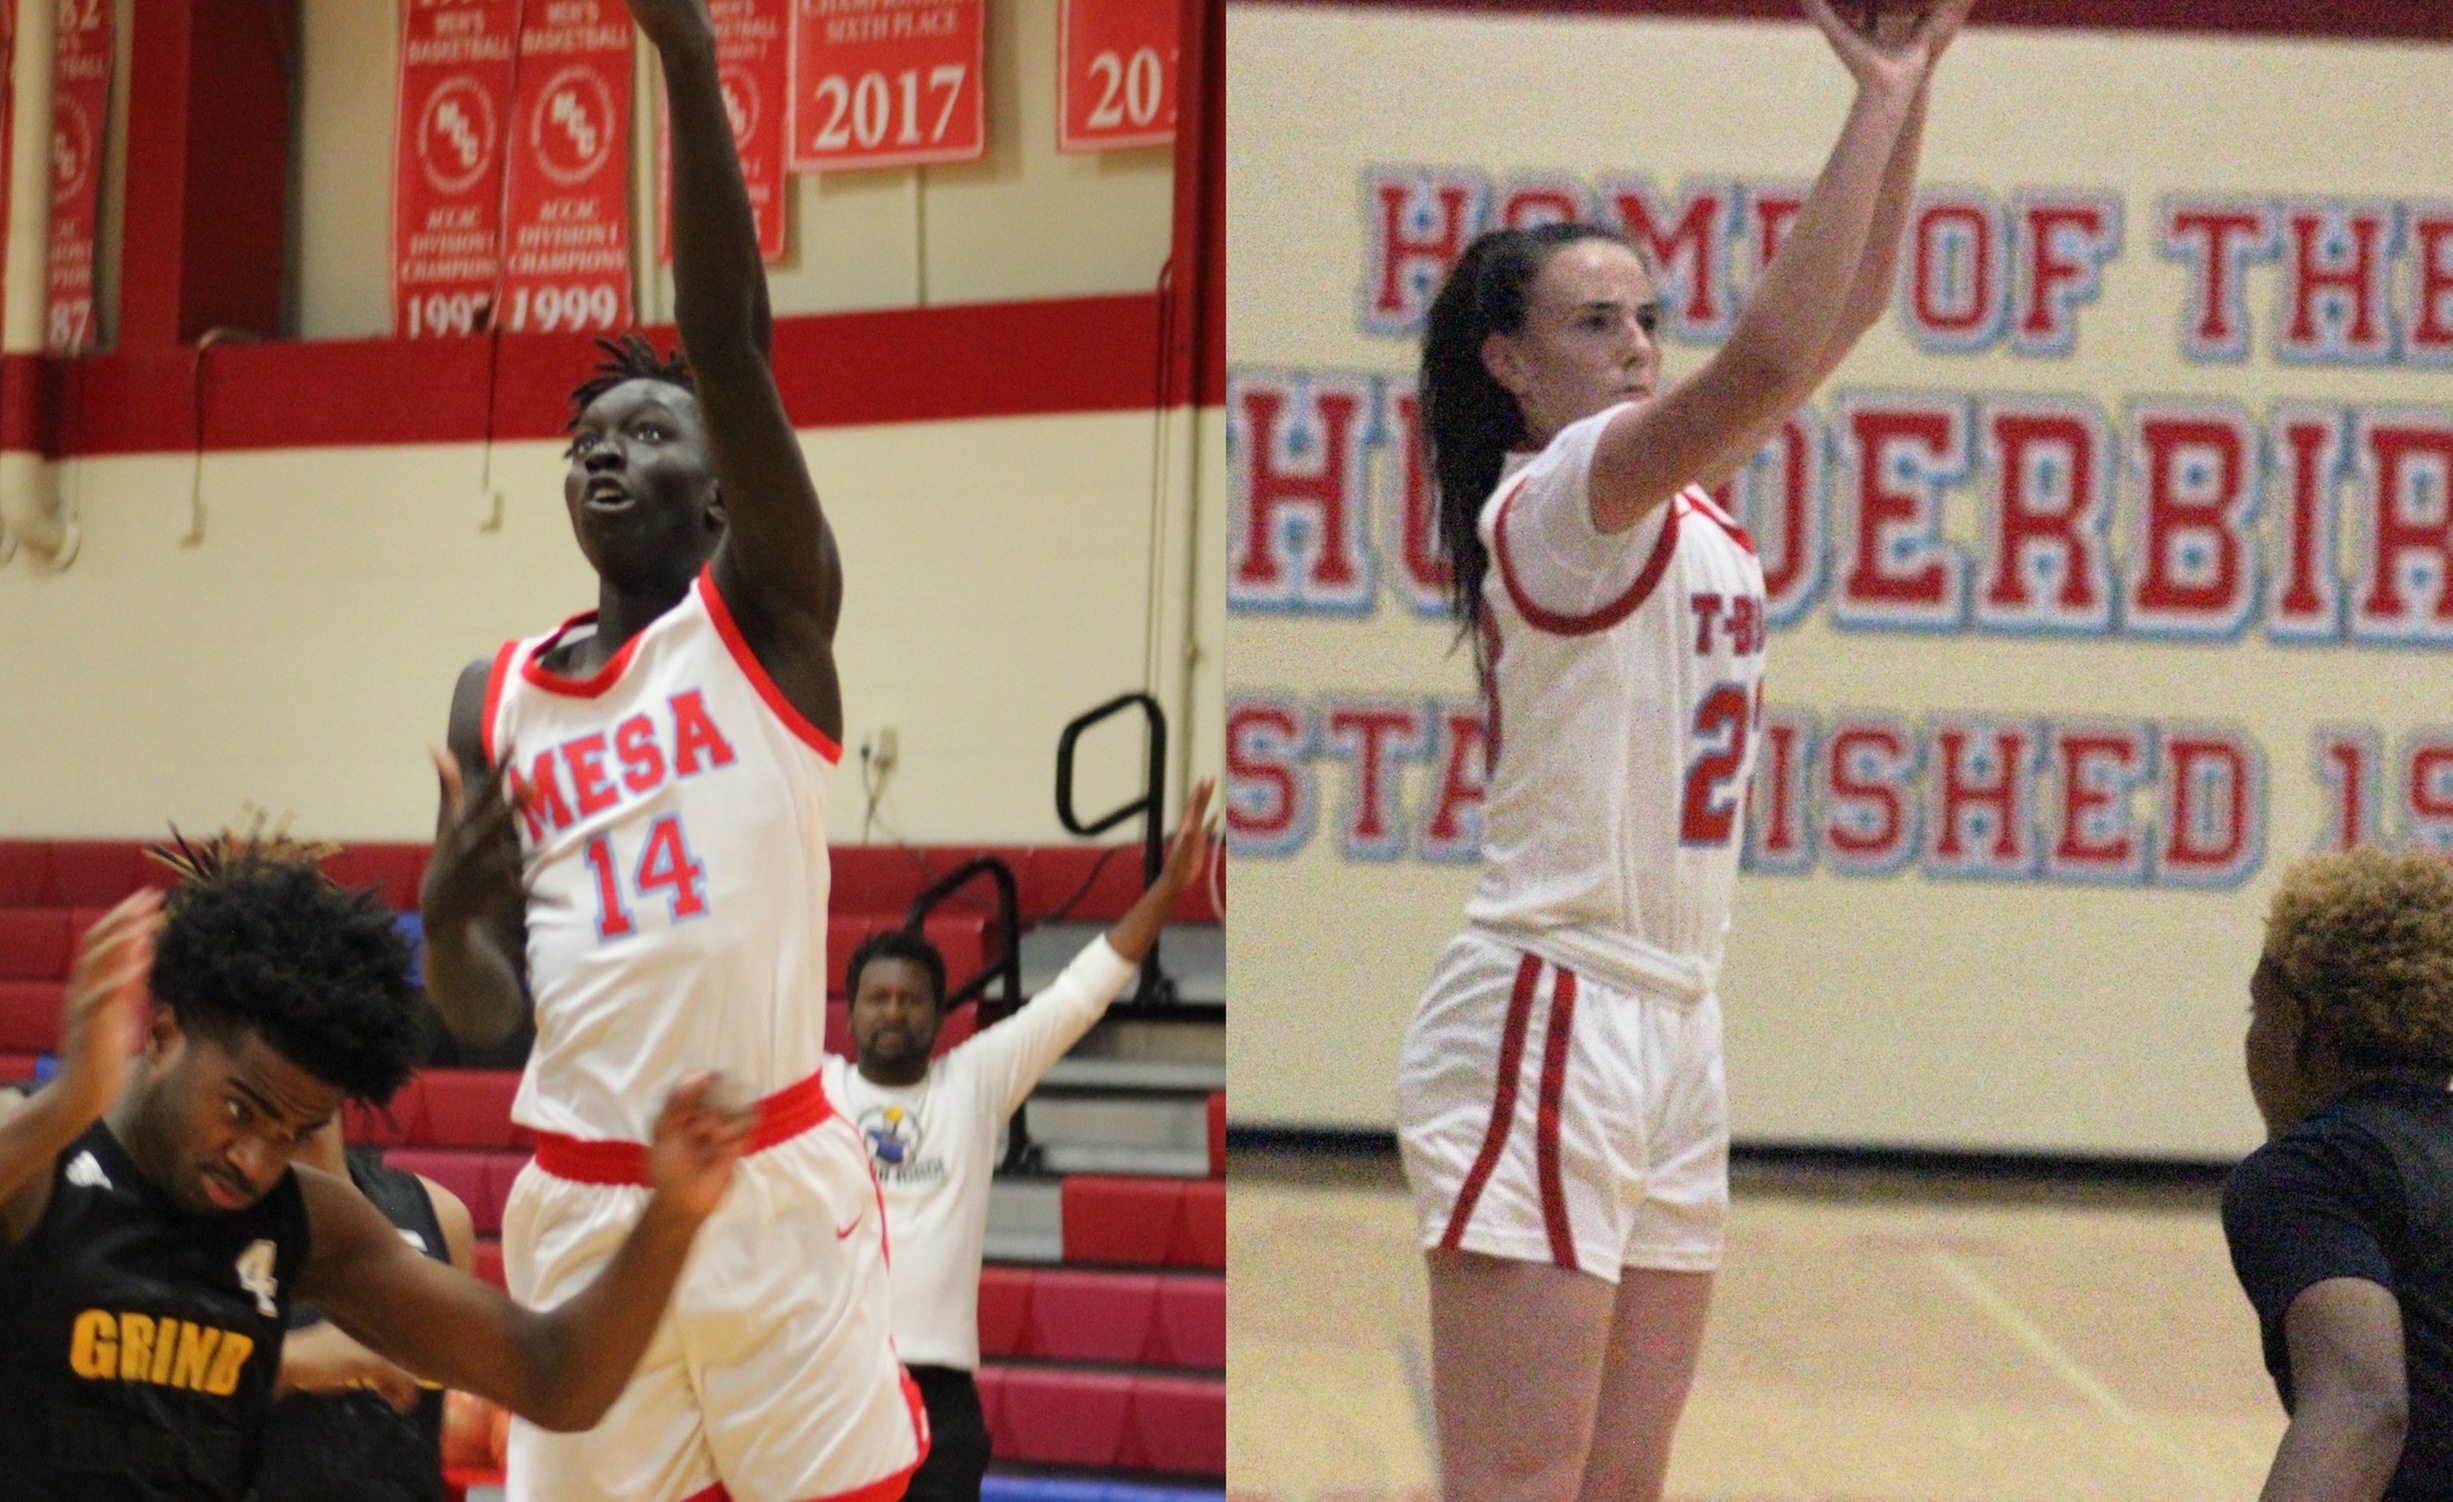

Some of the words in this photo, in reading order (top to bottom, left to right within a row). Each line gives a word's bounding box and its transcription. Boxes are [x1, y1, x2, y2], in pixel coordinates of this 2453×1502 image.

[826, 14, 889, 44] SIXTH
[892, 8, 957, 38] PLACE
[814, 63, 966, 150] 2017
[1087, 48, 1179, 130] 20
[512, 283, 618, 333] 1999
[1908, 188, 2122, 354] OF
[509, 686, 738, 844] MESA
[584, 808, 711, 945] 14
[236, 1239, 279, 1318] 4
